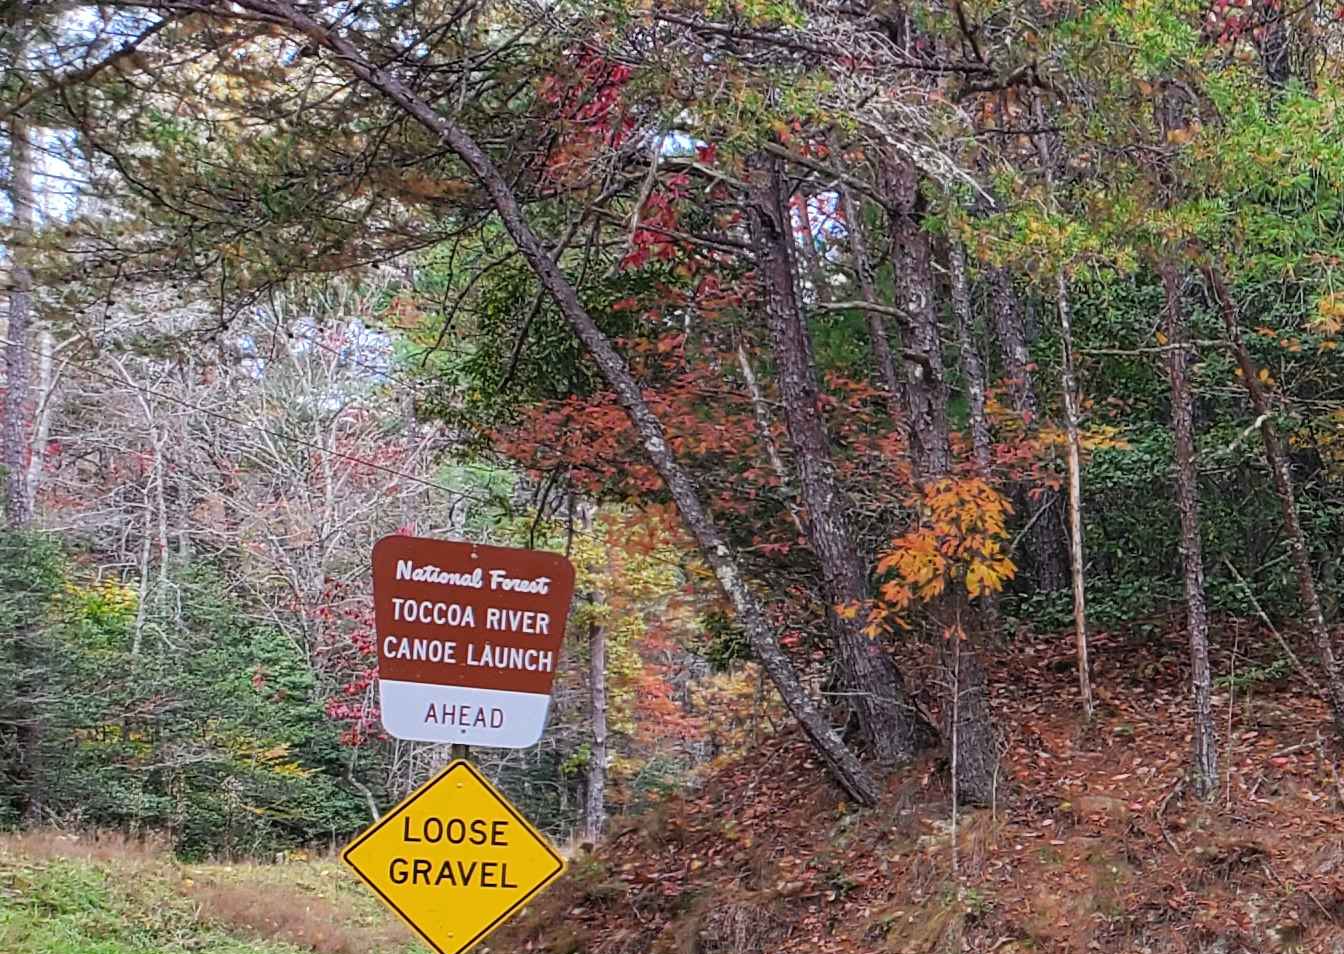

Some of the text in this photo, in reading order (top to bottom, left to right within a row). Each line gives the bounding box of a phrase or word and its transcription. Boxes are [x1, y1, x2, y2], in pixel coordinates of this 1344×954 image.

[396, 560, 551, 595] National Forest
[392, 598, 550, 635] TOCCOA RIVER
[383, 636, 553, 672] CANOE LAUNCH
[424, 703, 504, 729] AHEAD
[403, 816, 509, 846] LOOSE
[389, 858, 518, 889] GRAVEL
